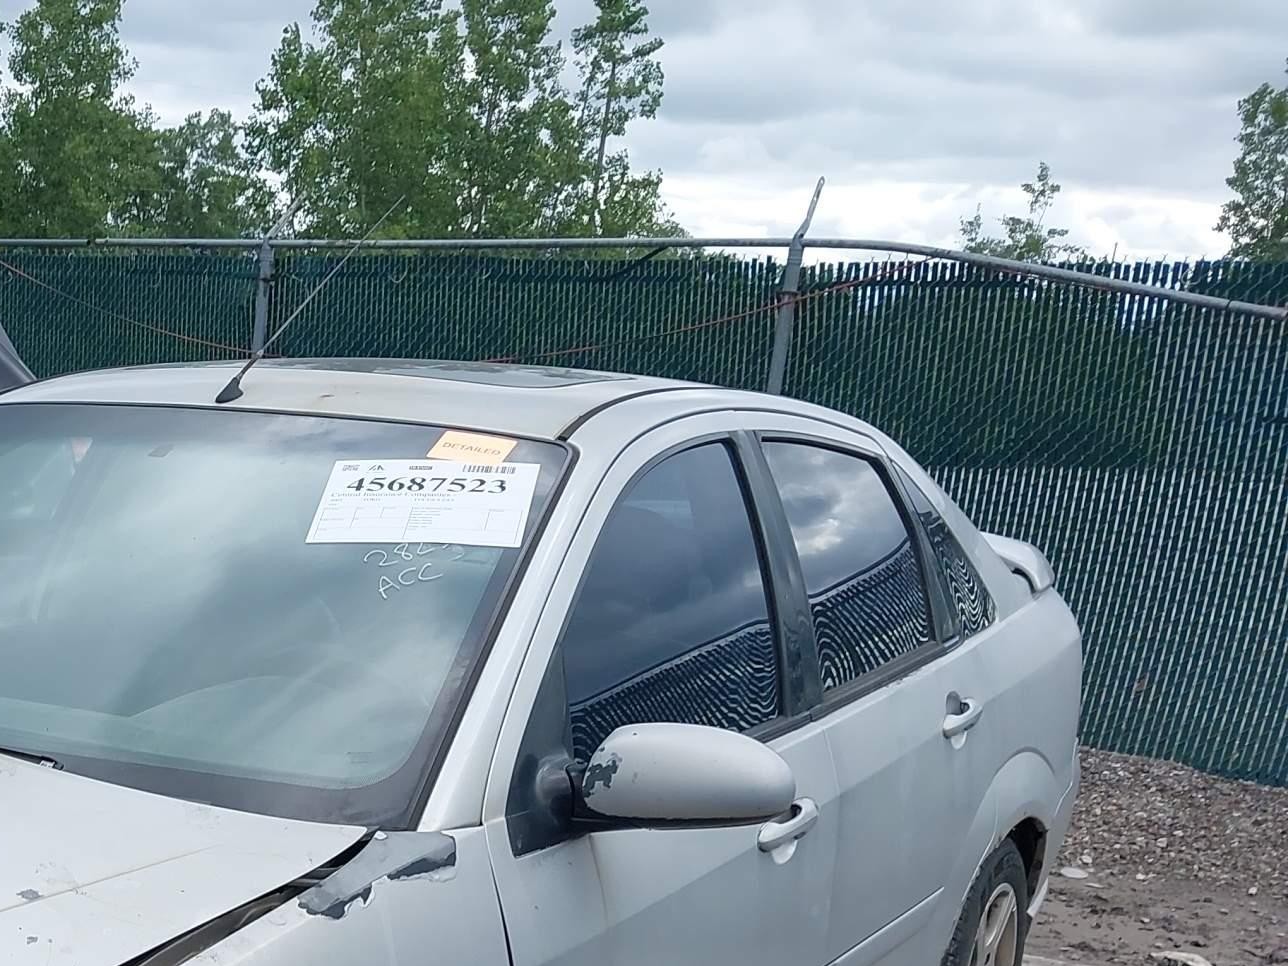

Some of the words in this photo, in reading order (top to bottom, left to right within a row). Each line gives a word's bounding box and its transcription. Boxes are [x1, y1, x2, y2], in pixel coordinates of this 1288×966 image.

[441, 441, 502, 457] DETAILED
[346, 476, 508, 495] 45687523
[378, 562, 444, 600] ACC
